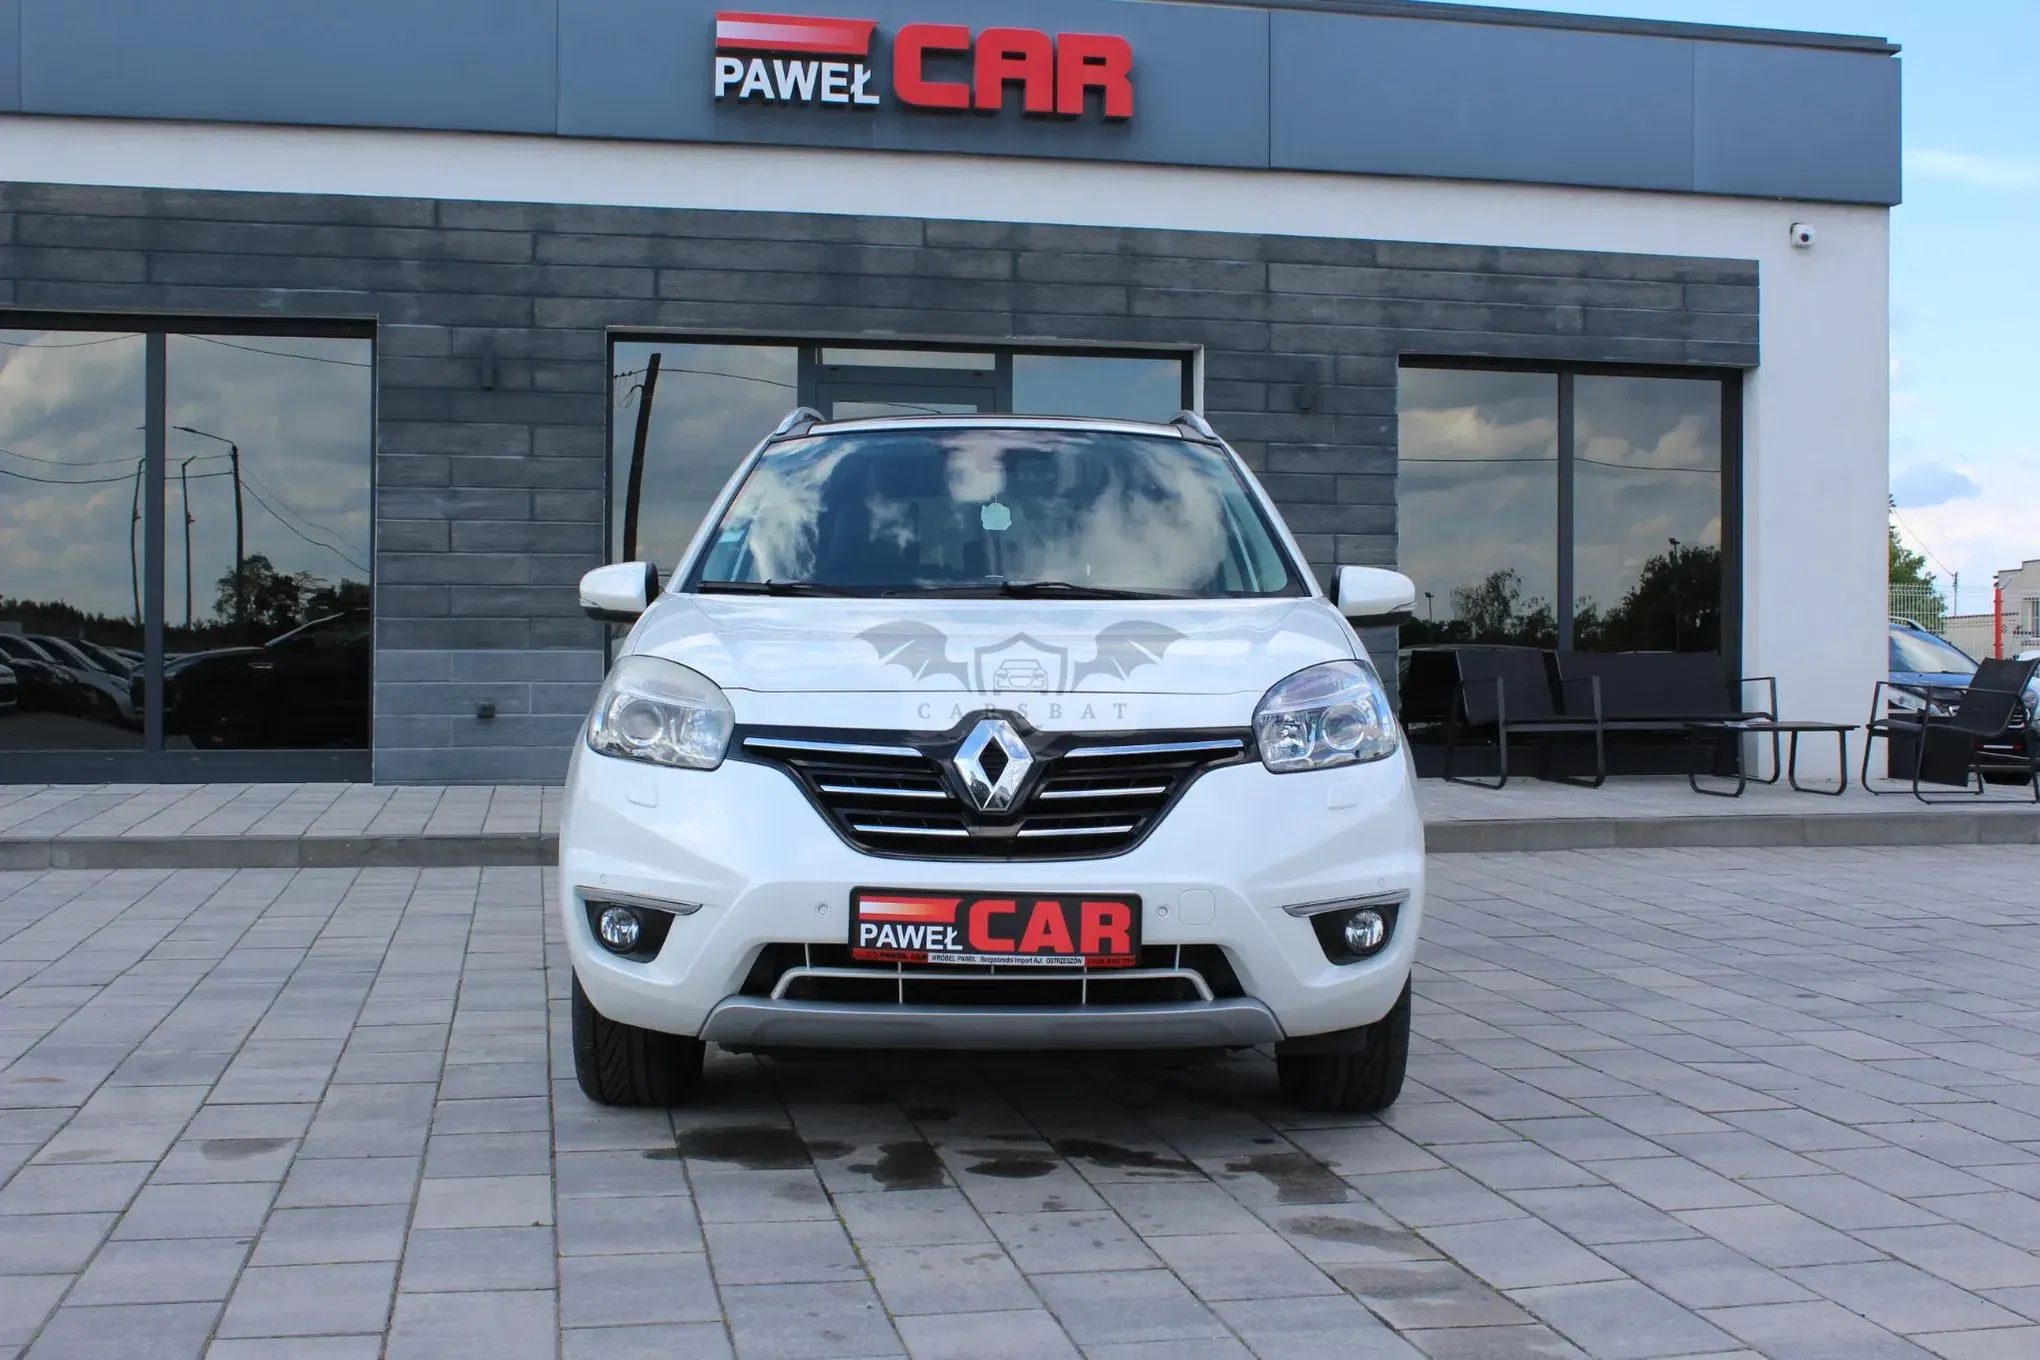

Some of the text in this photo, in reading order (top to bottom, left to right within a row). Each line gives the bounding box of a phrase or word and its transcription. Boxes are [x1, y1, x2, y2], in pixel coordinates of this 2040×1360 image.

[714, 23, 1133, 118] PAWEŁ CAR
[859, 899, 1132, 954] PAWEŁ CAR
